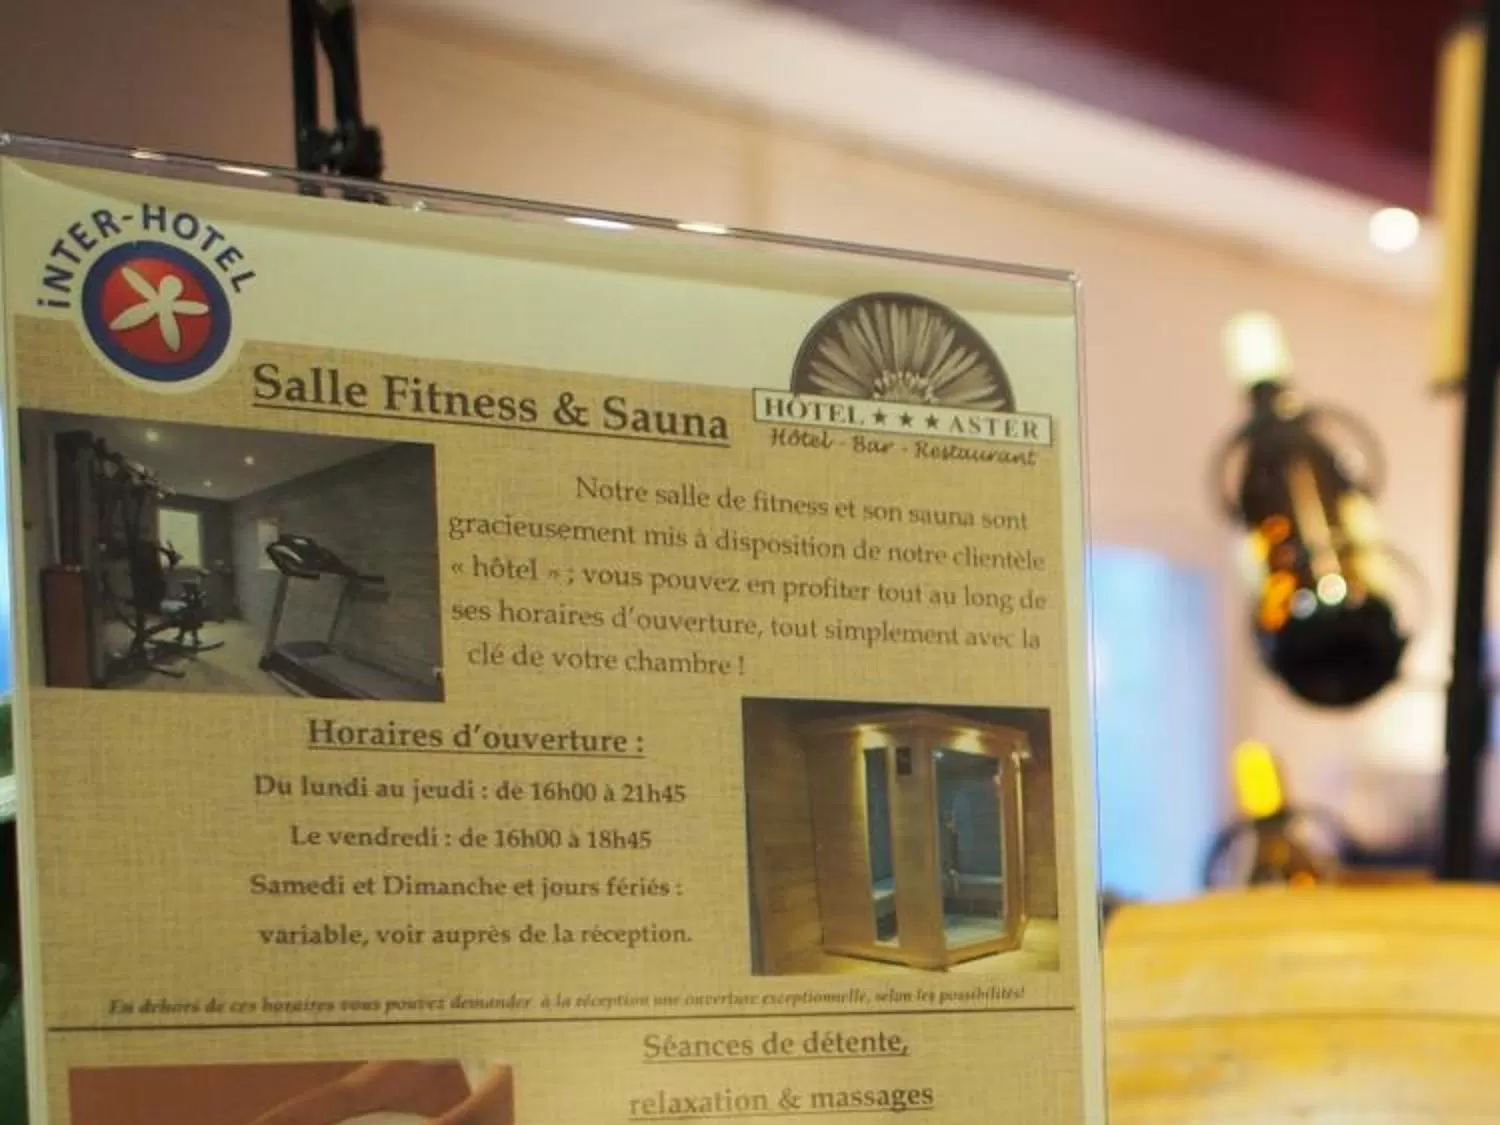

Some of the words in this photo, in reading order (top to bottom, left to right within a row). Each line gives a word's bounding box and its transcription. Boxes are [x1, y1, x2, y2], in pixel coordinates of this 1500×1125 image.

[252, 362, 368, 408] Salle
[383, 373, 538, 423] Fitness
[553, 390, 587, 428] &
[601, 394, 728, 440] Sauna
[949, 414, 1039, 438] ASTER
[770, 428, 832, 449] Hôtel
[851, 434, 890, 454] Bar
[913, 439, 1038, 466] Restaurant
[575, 474, 649, 503] Notre
[654, 482, 711, 508] salle
[716, 485, 746, 511] de
[752, 488, 829, 516] fitness
[833, 498, 857, 519] et
[862, 503, 902, 523] son
[908, 507, 975, 528] sauna
[980, 511, 1028, 532] sont
[448, 512, 636, 545] gracieusement
[643, 524, 688, 547] mis
[693, 527, 708, 549] à
[714, 527, 846, 561] disposition
[852, 537, 881, 561] de
[886, 543, 946, 565] notre
[951, 544, 1045, 571] clientèle
[471, 552, 537, 581] hôtel
[581, 567, 643, 587] vous
[649, 571, 741, 596] pouvez
[746, 577, 776, 596] en
[782, 575, 869, 604] profiter
[876, 582, 923, 604] tout
[928, 589, 956, 608] au
[962, 582, 1014, 614] long
[1019, 587, 1047, 610] de
[450, 603, 491, 621] ses
[497, 596, 605, 627] horaires
[769, 616, 817, 638] tout
[824, 617, 959, 649] simplement
[963, 630, 1014, 649] avec
[1020, 626, 1041, 650] la
[466, 640, 505, 667] clé
[511, 641, 545, 668] de
[551, 647, 617, 670] votre
[623, 647, 732, 676] chambre
[307, 718, 443, 748] Horaires
[253, 773, 292, 796] Du
[300, 773, 368, 798] lundi
[375, 782, 404, 798] au
[411, 777, 475, 805] jeudi
[495, 779, 525, 801] de
[532, 779, 597, 802] 16h00
[602, 782, 614, 803] à
[621, 782, 686, 804] 21h45
[289, 824, 322, 846] Le
[327, 824, 438, 847] vendredi
[458, 824, 488, 848] de
[493, 827, 562, 849] 16h00
[567, 831, 580, 849] à
[588, 828, 653, 849] 18h45
[248, 873, 346, 896] Samedi
[352, 877, 375, 896] et
[382, 874, 507, 896] Dimanche
[512, 878, 534, 896] et
[541, 876, 600, 901] jours
[257, 922, 369, 947] variable,
[375, 922, 423, 945] voir
[431, 924, 511, 951] auprès
[518, 923, 547, 944] de
[553, 921, 574, 944] la
[642, 1033, 754, 1059] Séances
[761, 1030, 793, 1056] de
[801, 1029, 910, 1059] détente,
[627, 1086, 769, 1116] relaxation
[777, 1086, 801, 1111] &
[809, 1087, 934, 1114] massages
